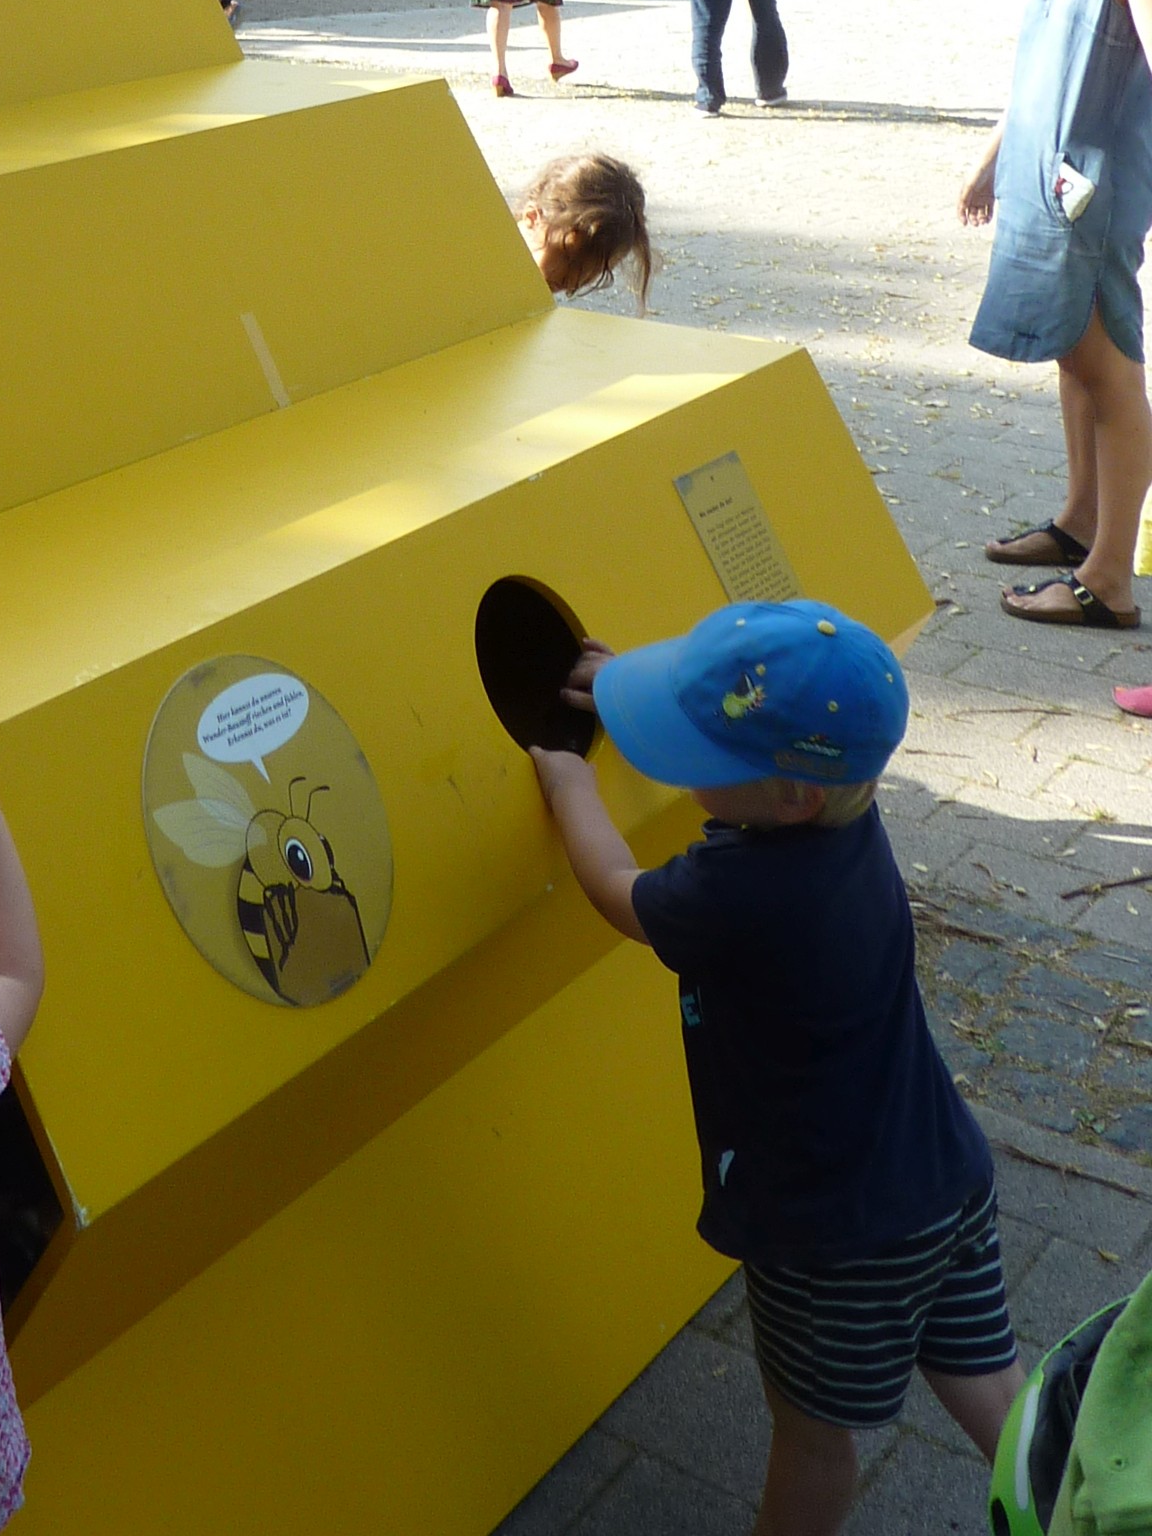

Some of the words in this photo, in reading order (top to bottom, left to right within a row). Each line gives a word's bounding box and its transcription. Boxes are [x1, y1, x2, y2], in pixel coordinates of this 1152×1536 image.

[251, 695, 259, 707] du
[272, 695, 285, 710] und
[264, 718, 275, 729] was
